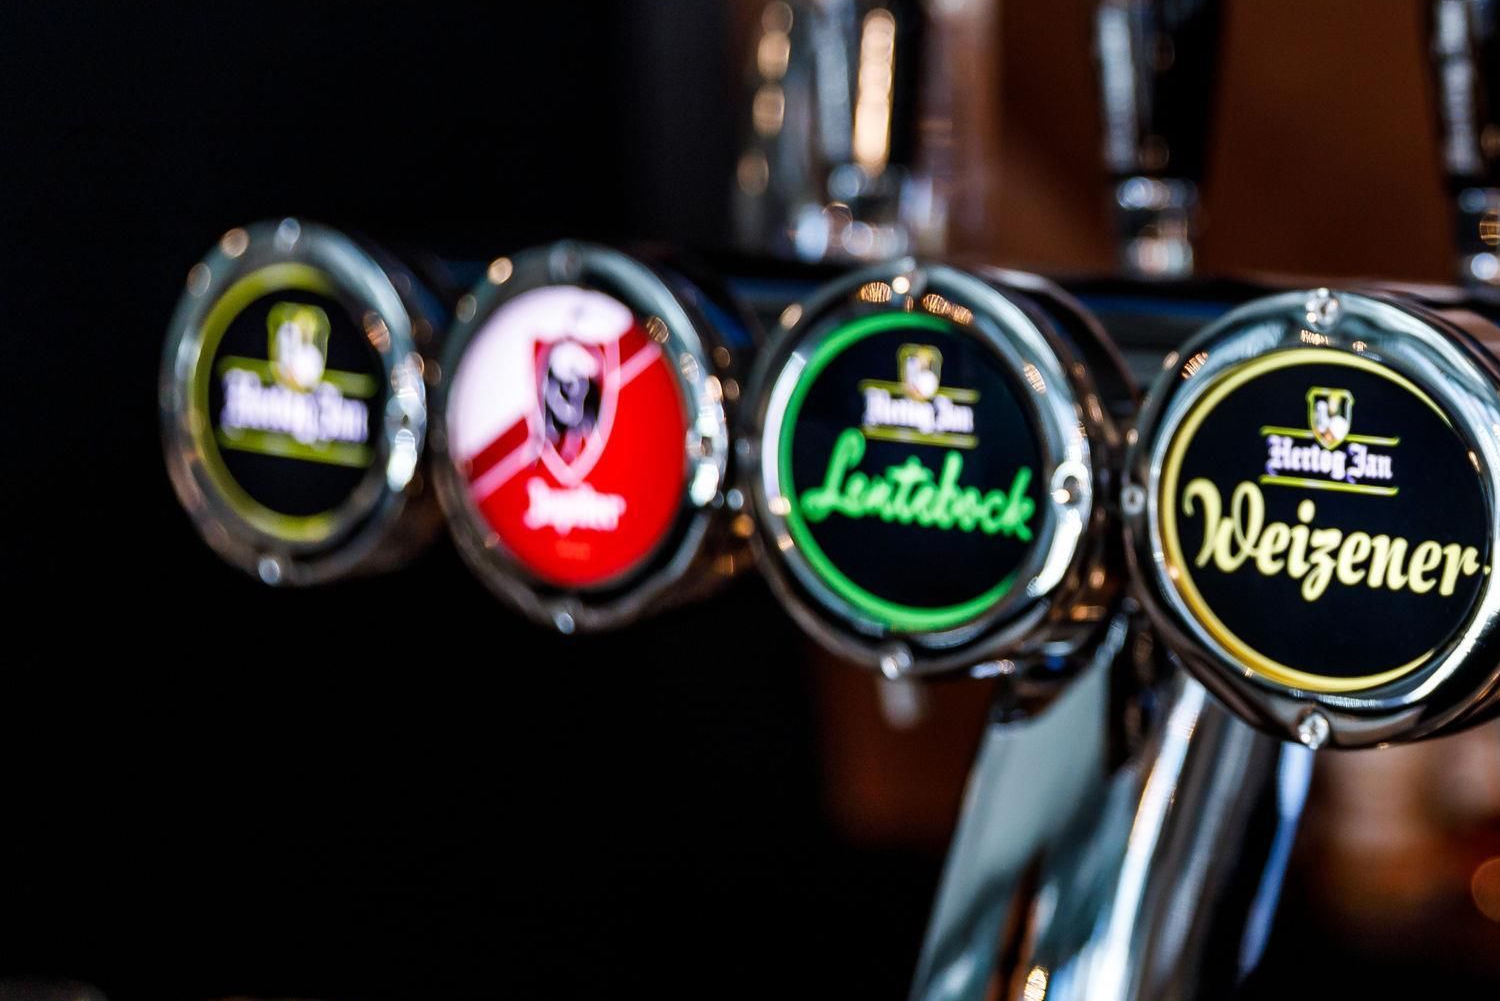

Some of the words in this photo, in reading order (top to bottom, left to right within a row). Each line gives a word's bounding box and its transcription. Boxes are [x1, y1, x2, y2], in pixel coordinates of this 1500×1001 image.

[1266, 435, 1347, 480] Hertog
[1347, 442, 1393, 484] Jan
[1183, 478, 1481, 601] Weizener
